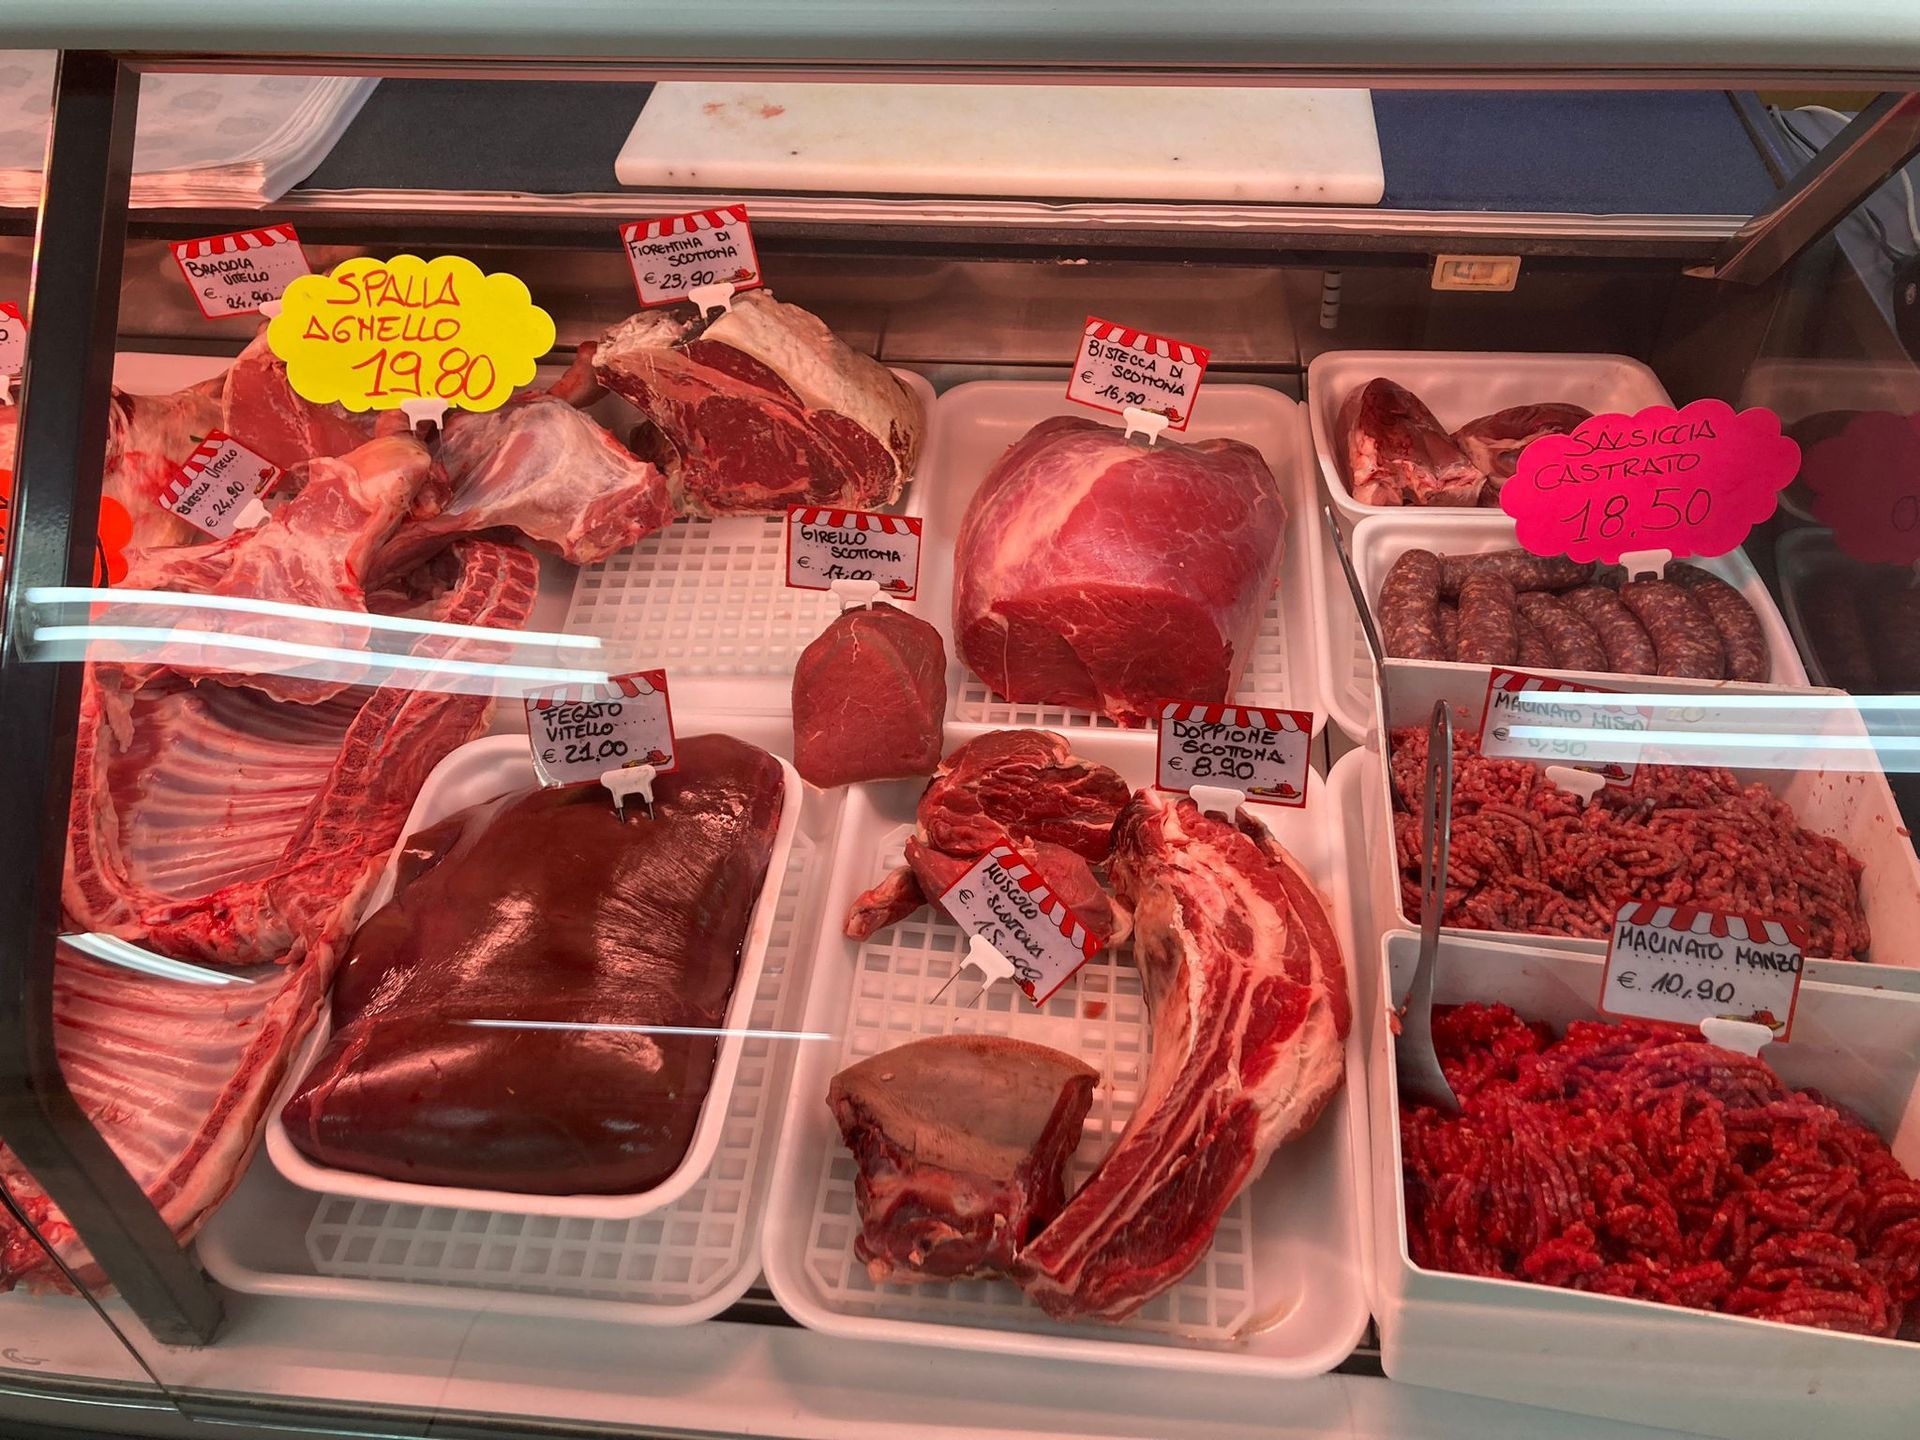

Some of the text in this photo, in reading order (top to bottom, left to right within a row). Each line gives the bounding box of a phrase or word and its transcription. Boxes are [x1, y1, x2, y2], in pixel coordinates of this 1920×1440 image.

[628, 231, 731, 259] FIORENTINA DI
[668, 245, 738, 267] SCOTTONA
[326, 269, 460, 309] SPALLA
[659, 270, 714, 290] 23,90
[302, 314, 460, 343] AGNELLO
[351, 347, 496, 401] 19.80
[1088, 339, 1183, 379] BISTECCA DI
[1111, 365, 1185, 397] SCOTTONA
[1563, 419, 1717, 457] SALSICCIA
[1534, 453, 1700, 490] CASTRATO
[1560, 488, 1712, 543] 18.50
[801, 524, 867, 546] GIRELLO
[830, 545, 902, 562] SCOTTONA
[540, 702, 623, 727] FEGATO
[546, 722, 614, 742] VITELLO
[1173, 721, 1278, 745] DOPPIONE
[1181, 740, 1285, 764] SCOTTONA
[982, 862, 1039, 920] MUSCOLO
[1616, 925, 1724, 961] MACINATO
[1650, 971, 1735, 1004] 10,90
